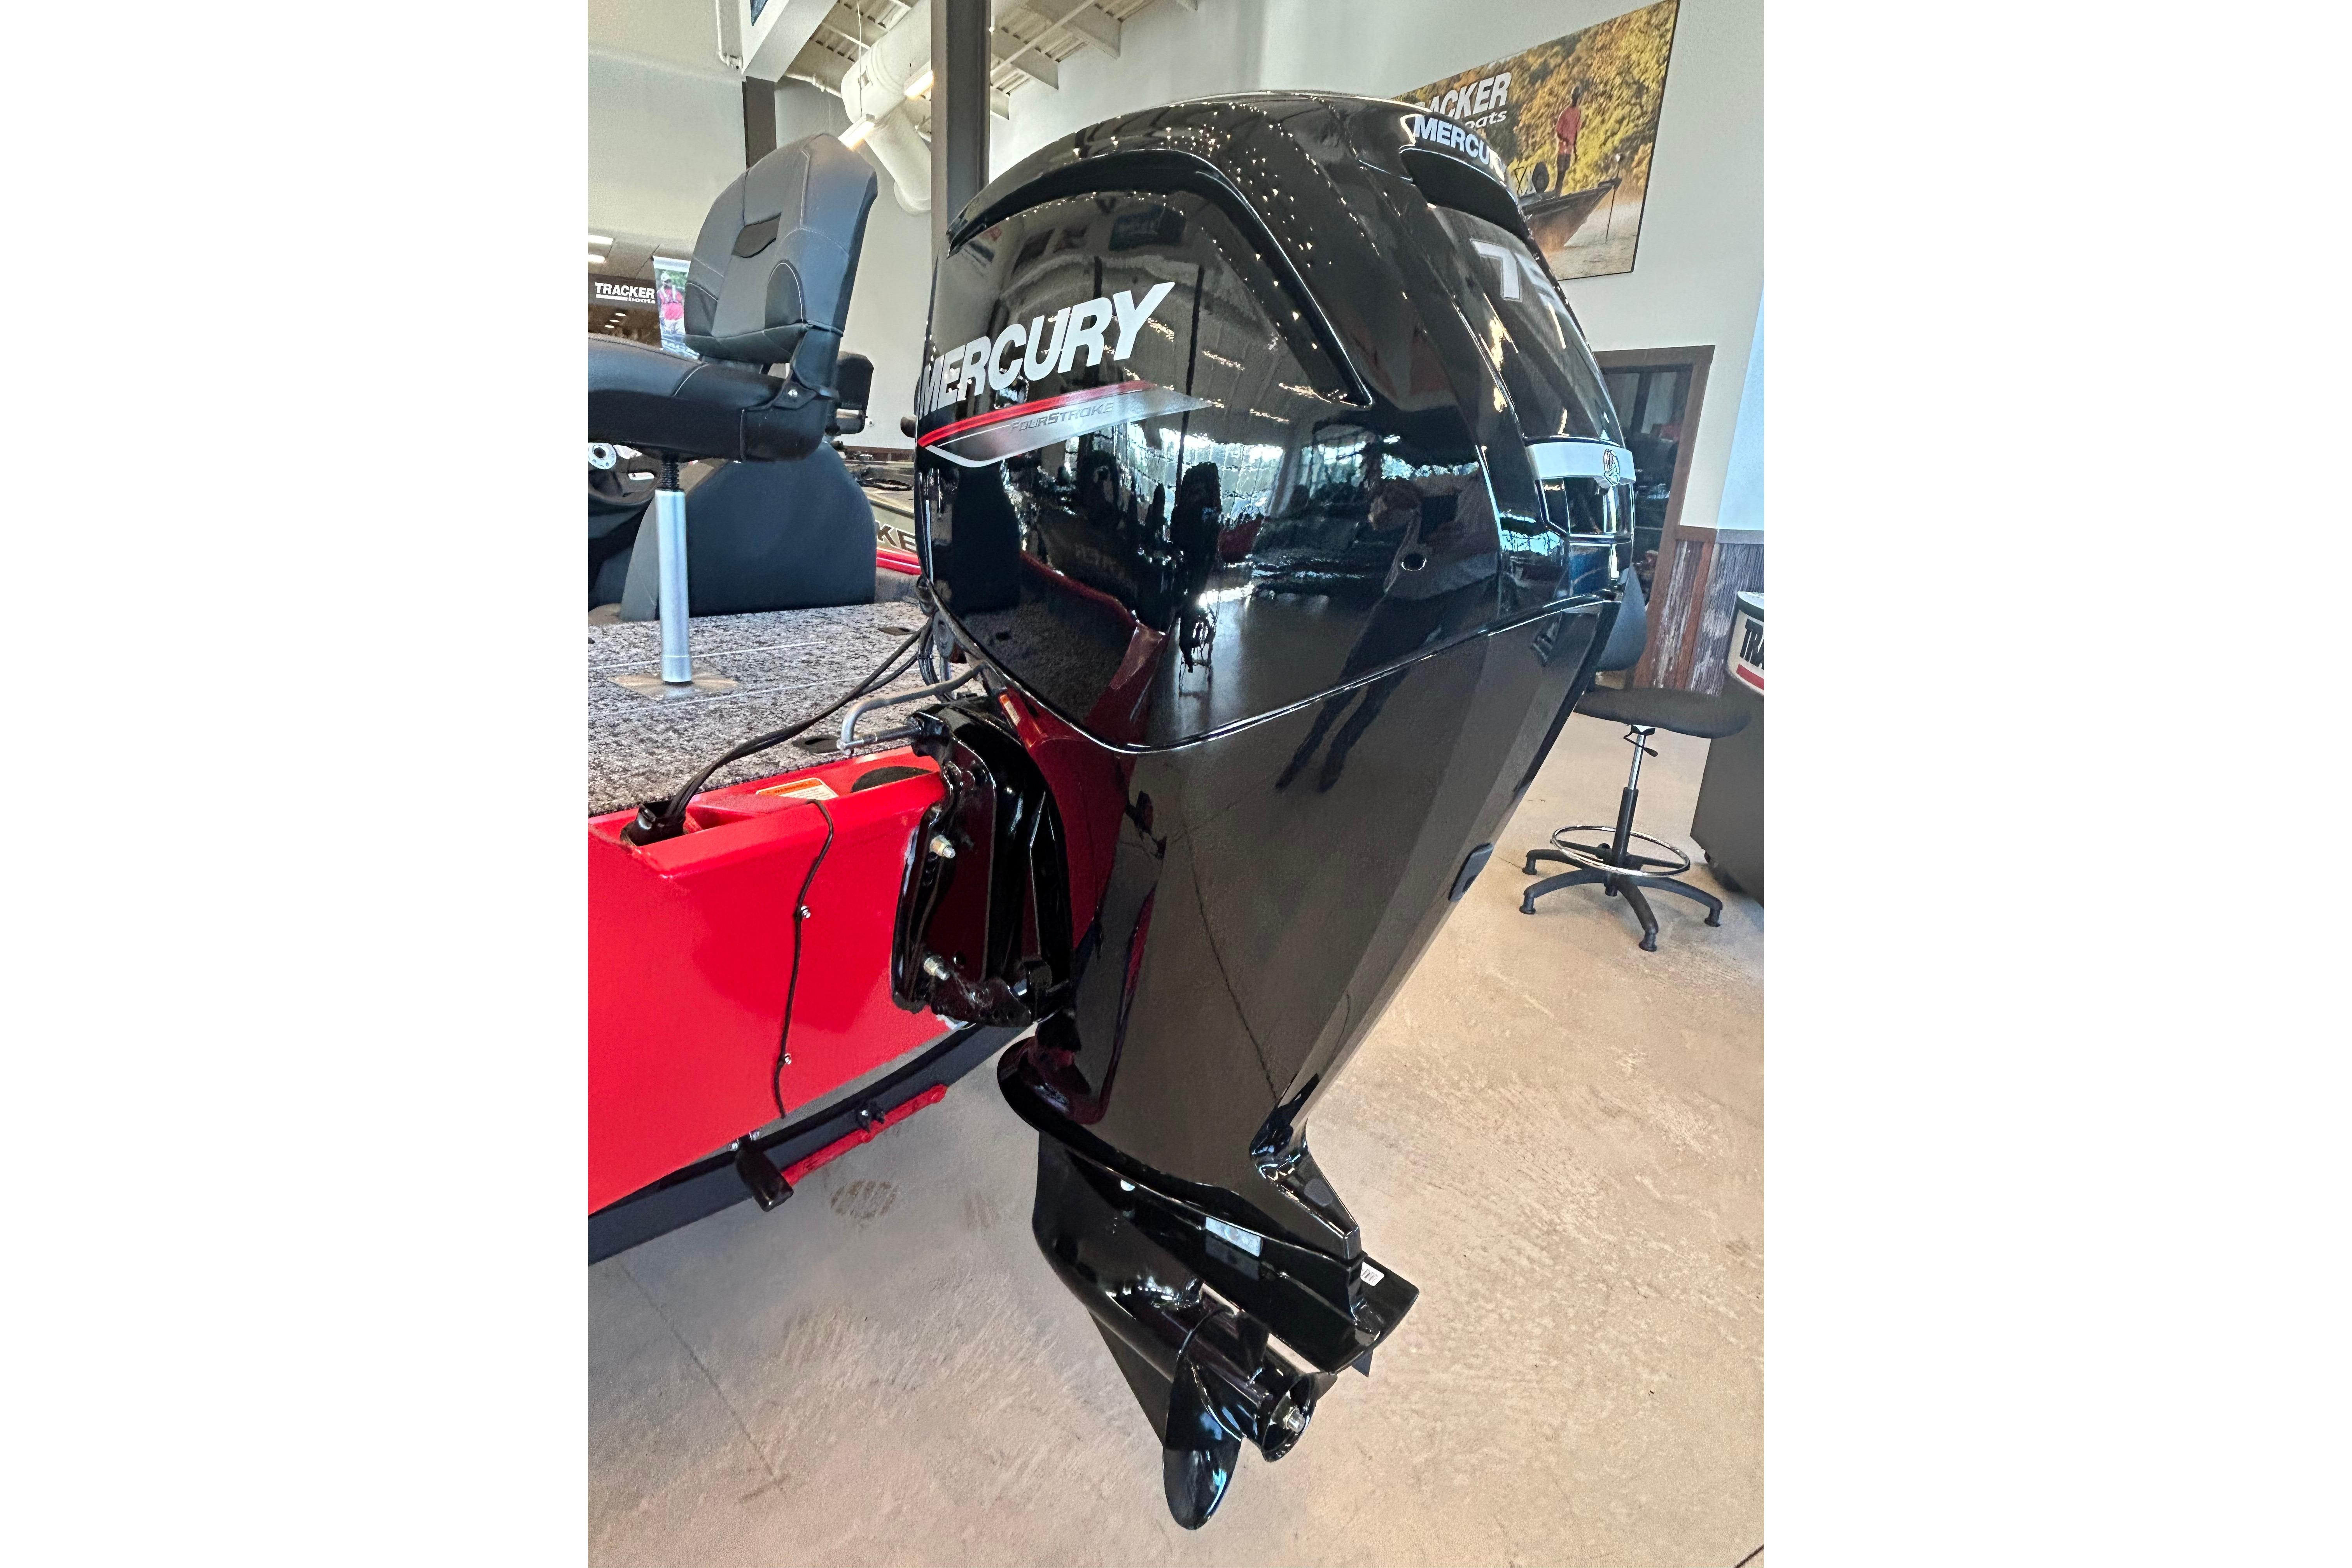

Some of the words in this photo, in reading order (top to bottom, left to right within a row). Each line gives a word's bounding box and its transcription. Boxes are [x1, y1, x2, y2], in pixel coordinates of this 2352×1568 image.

[1414, 72, 1512, 119] ACKER
[1414, 114, 1507, 174] MERCU
[595, 282, 655, 299] TRACKER
[917, 282, 1175, 420] MERCURY
